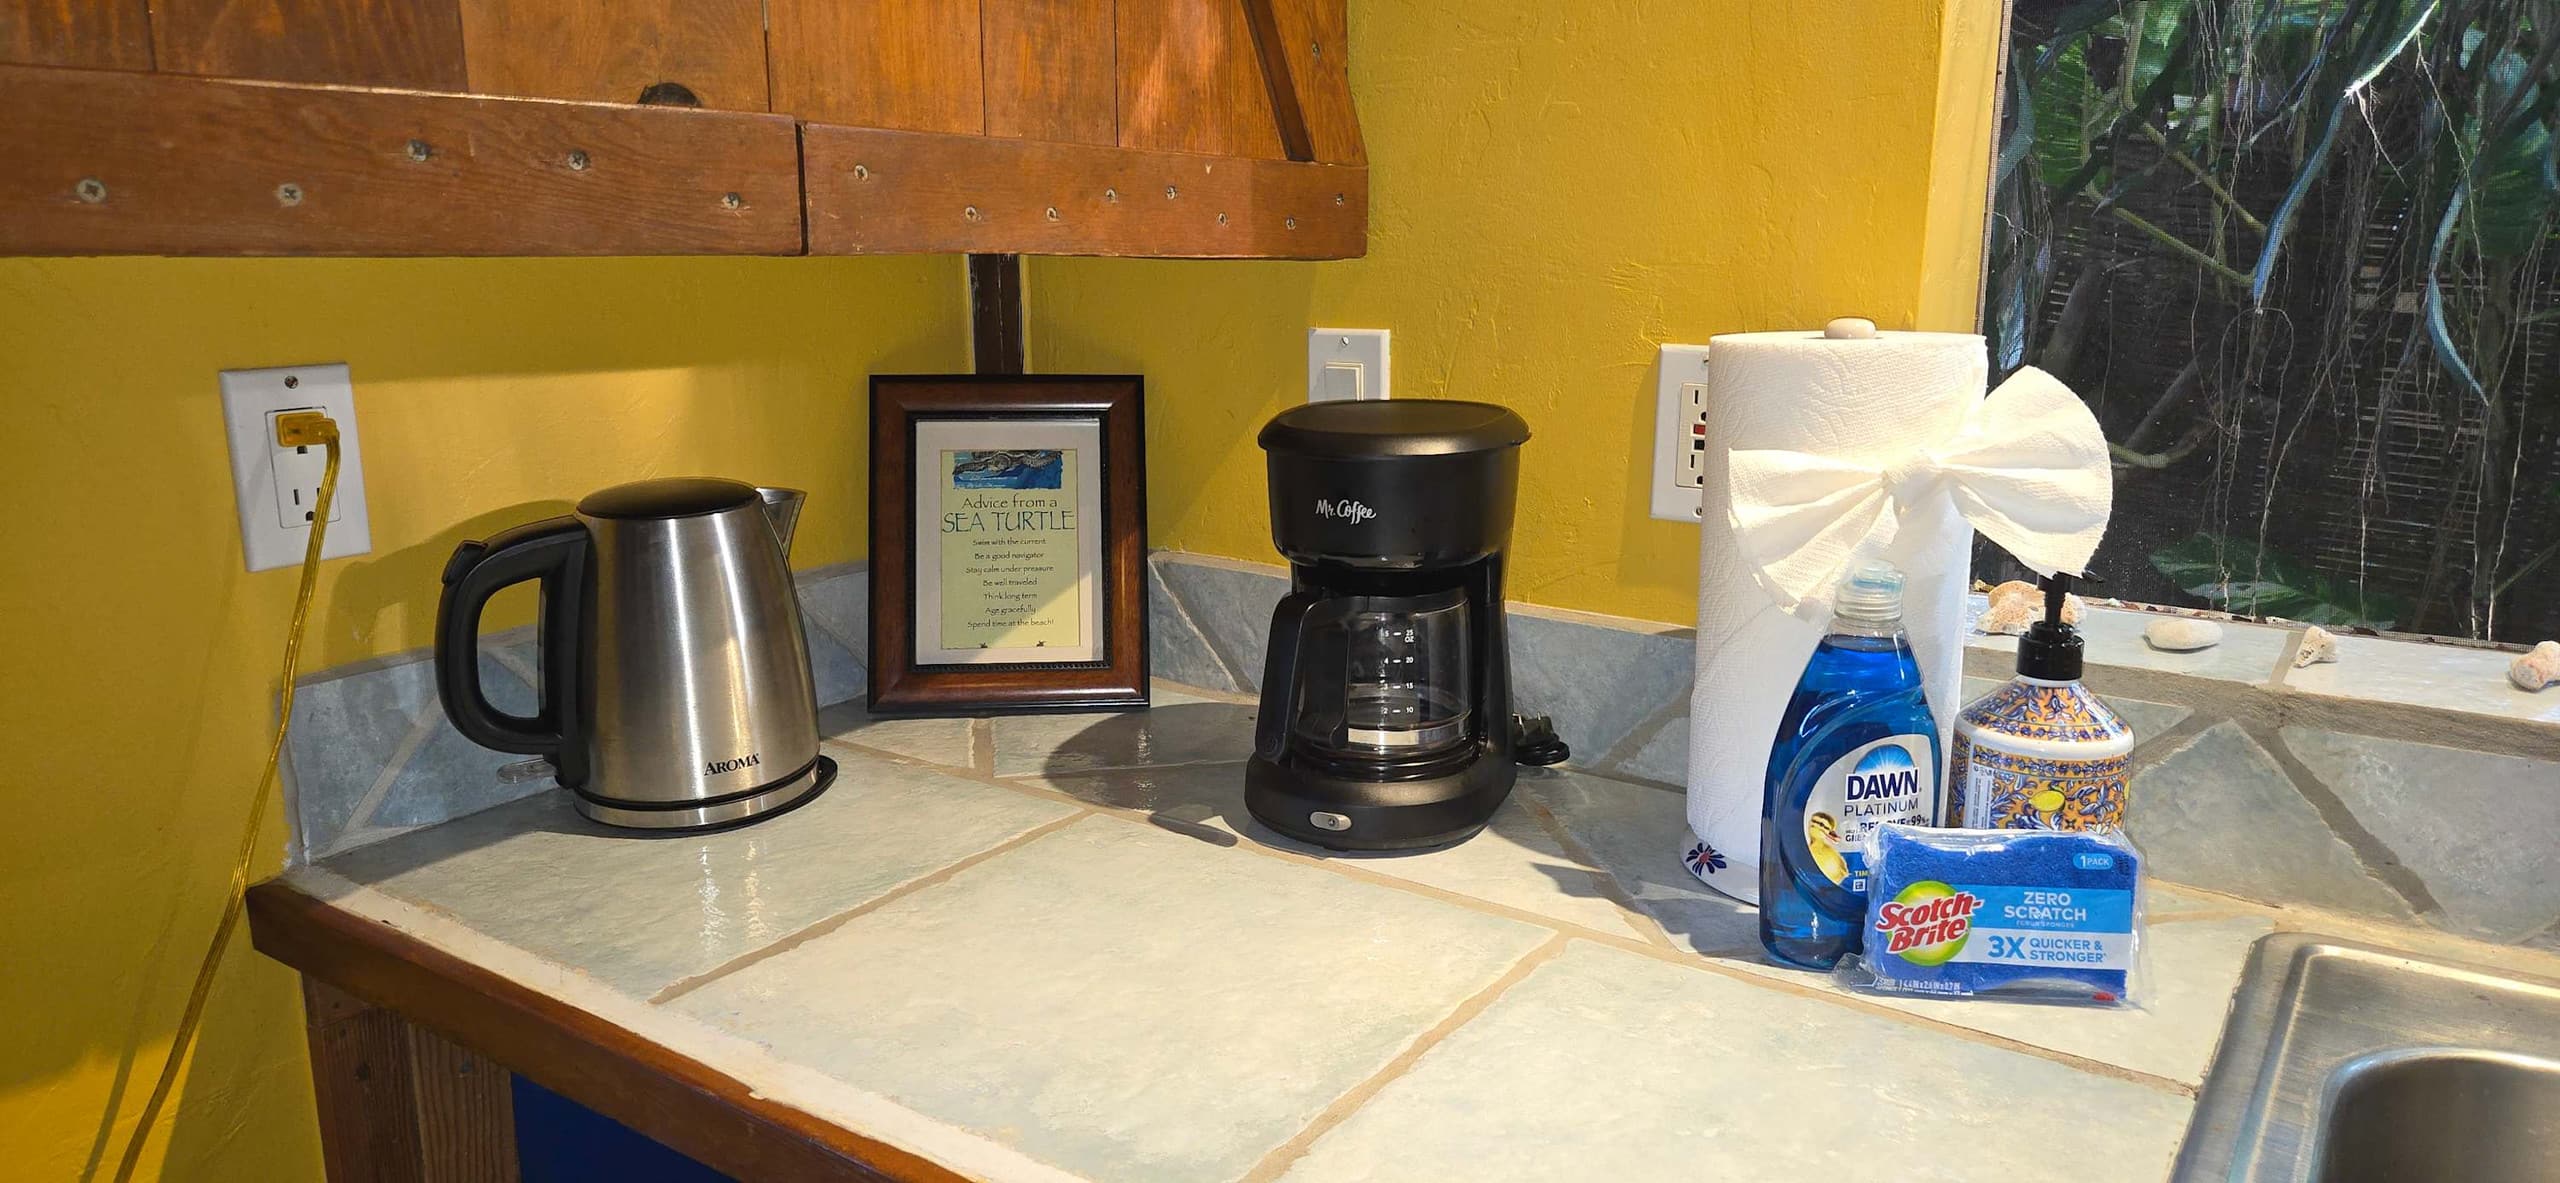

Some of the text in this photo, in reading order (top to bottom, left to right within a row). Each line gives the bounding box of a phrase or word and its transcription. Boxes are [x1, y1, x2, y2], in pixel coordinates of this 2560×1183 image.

[962, 493, 1058, 509] Advice from a
[1316, 499, 1377, 525] Mr. Coffee
[942, 510, 1076, 533] SEA TURTLE
[991, 537, 1006, 545] with
[992, 551, 1010, 561] good
[1012, 551, 1044, 560] navigator
[966, 564, 1054, 575] Stay calm under pressure
[994, 577, 1007, 586] well
[984, 591, 1003, 600] Think
[1004, 591, 1020, 601] long
[985, 604, 1036, 616] Age gracefully
[967, 619, 990, 630] Spend
[1384, 630, 1390, 638] 5
[1384, 656, 1414, 665] 4 20
[1406, 682, 1414, 690] 15
[1406, 706, 1414, 714] 10
[704, 753, 760, 776] AROMA
[1847, 769, 1919, 801] DAWN
[1844, 797, 1919, 817] PLATINUM
[2023, 891, 2071, 906] ZERO
[1875, 892, 1983, 931] Scotch-
[2004, 905, 2087, 921] SCRATCH
[1888, 918, 1968, 953] Brite
[1987, 935, 2026, 960] 3X
[2029, 937, 2103, 951] QUICKER &
